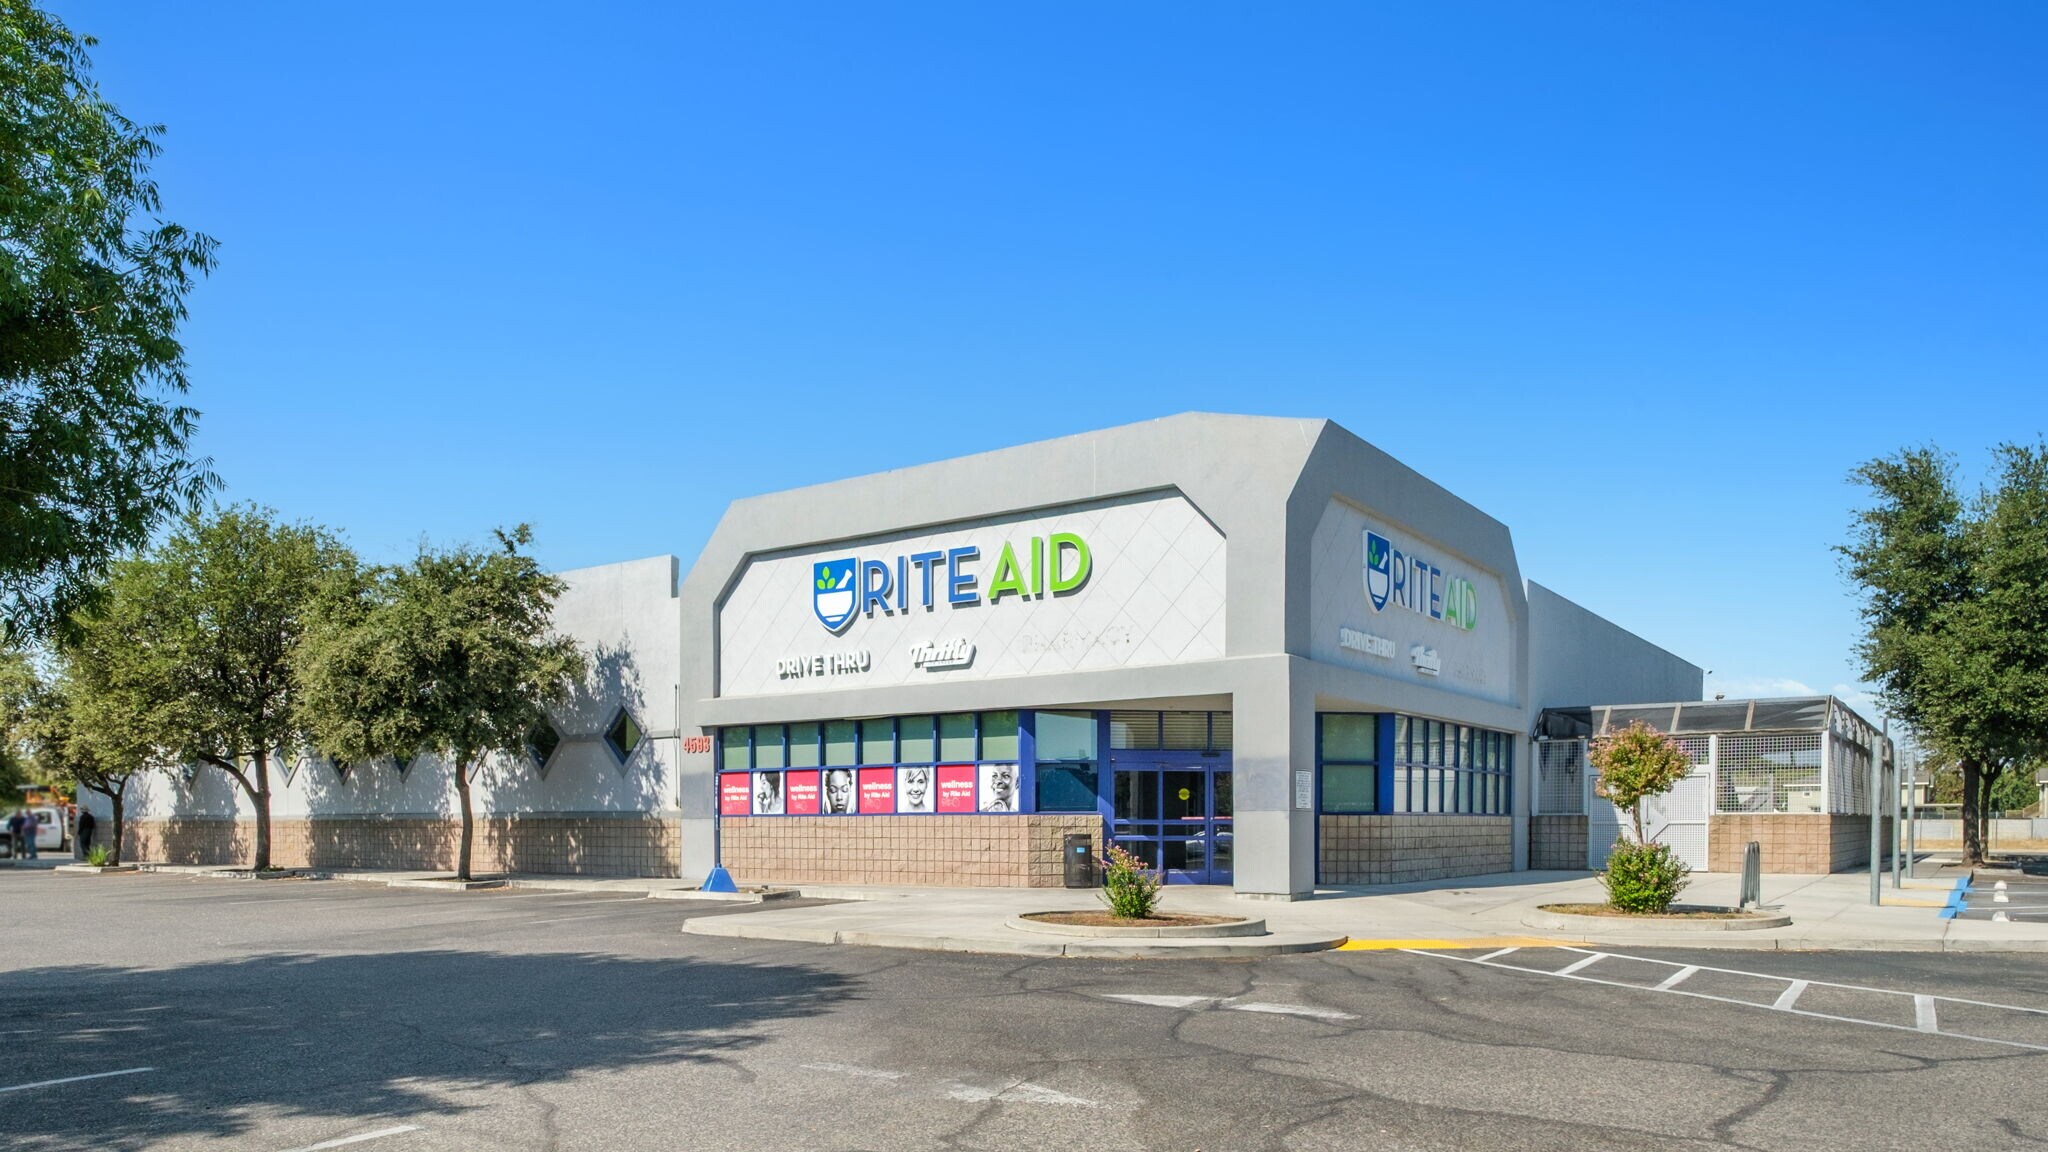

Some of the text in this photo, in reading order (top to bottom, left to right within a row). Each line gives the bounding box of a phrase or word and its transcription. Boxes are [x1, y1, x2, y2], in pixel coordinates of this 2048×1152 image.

[862, 532, 1092, 614] RITE AID
[1391, 548, 1478, 631] RITE AID
[776, 649, 872, 679] DRIVE THRU
[790, 784, 818, 792] wellness
[862, 781, 892, 790] wellness
[941, 780, 973, 789] wellness
